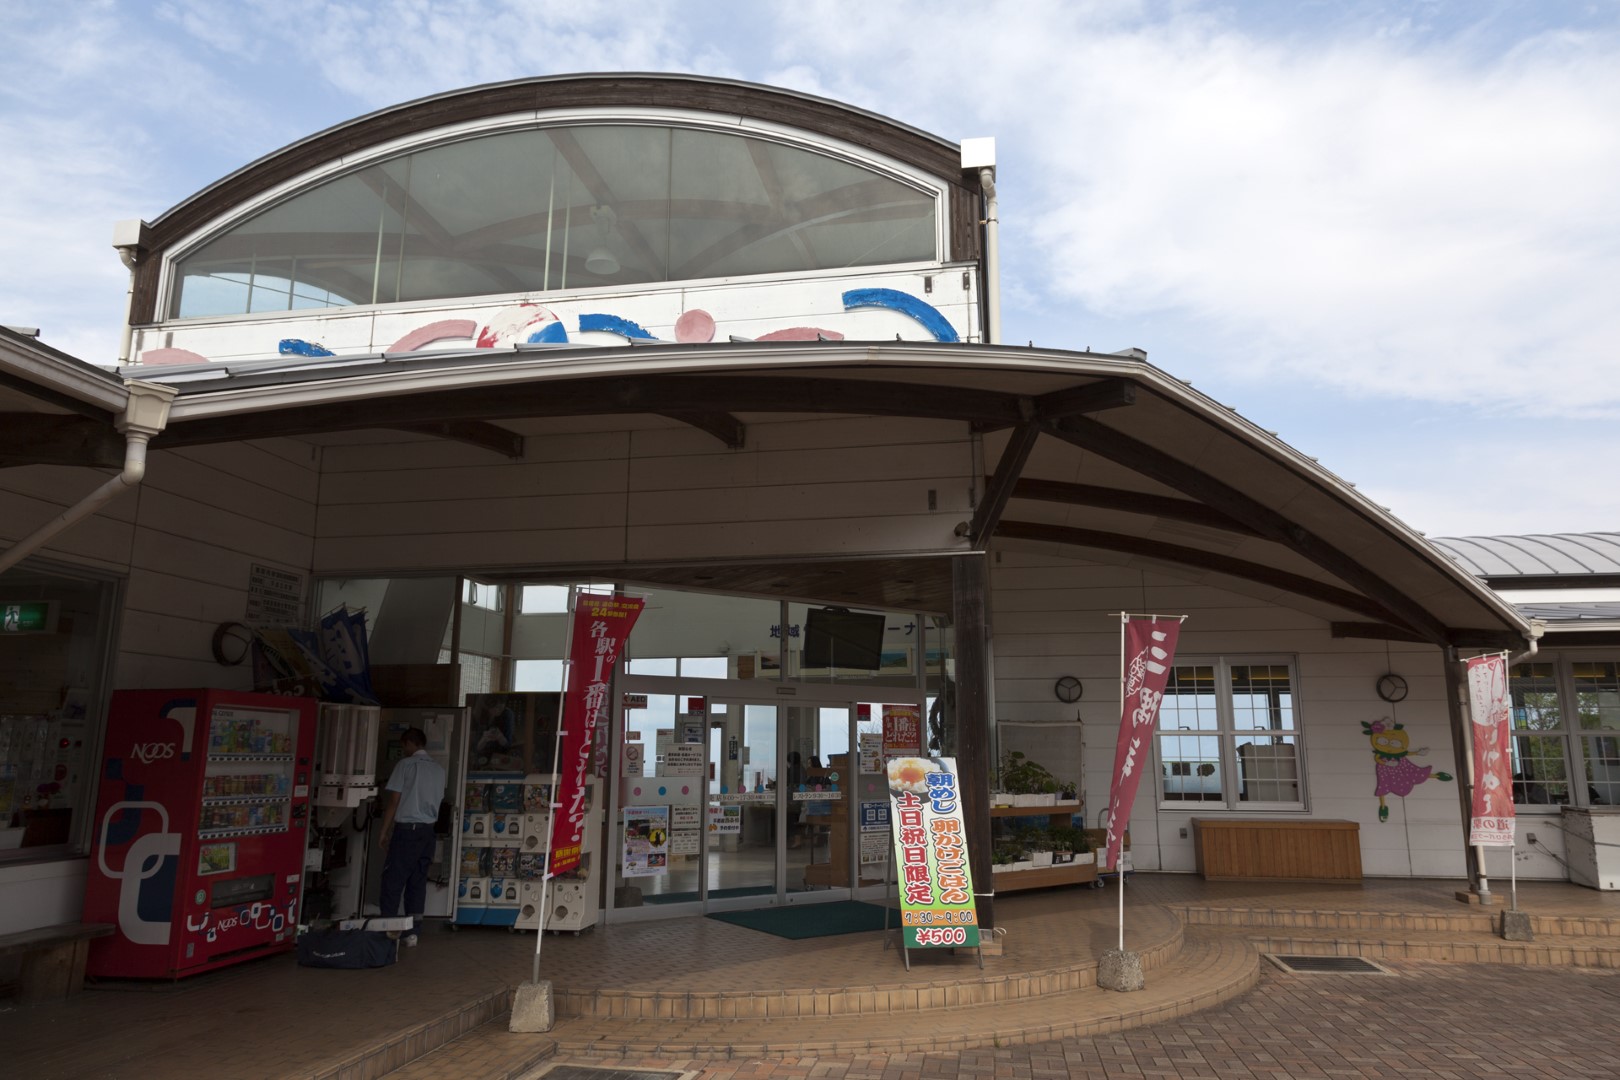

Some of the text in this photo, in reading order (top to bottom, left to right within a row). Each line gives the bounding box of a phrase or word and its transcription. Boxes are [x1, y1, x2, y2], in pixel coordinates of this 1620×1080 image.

[897, 792, 933, 905] 土日祝日限定
[926, 773, 969, 903] 朝めし 卵かけごはん
[916, 928, 966, 945] ¥500
